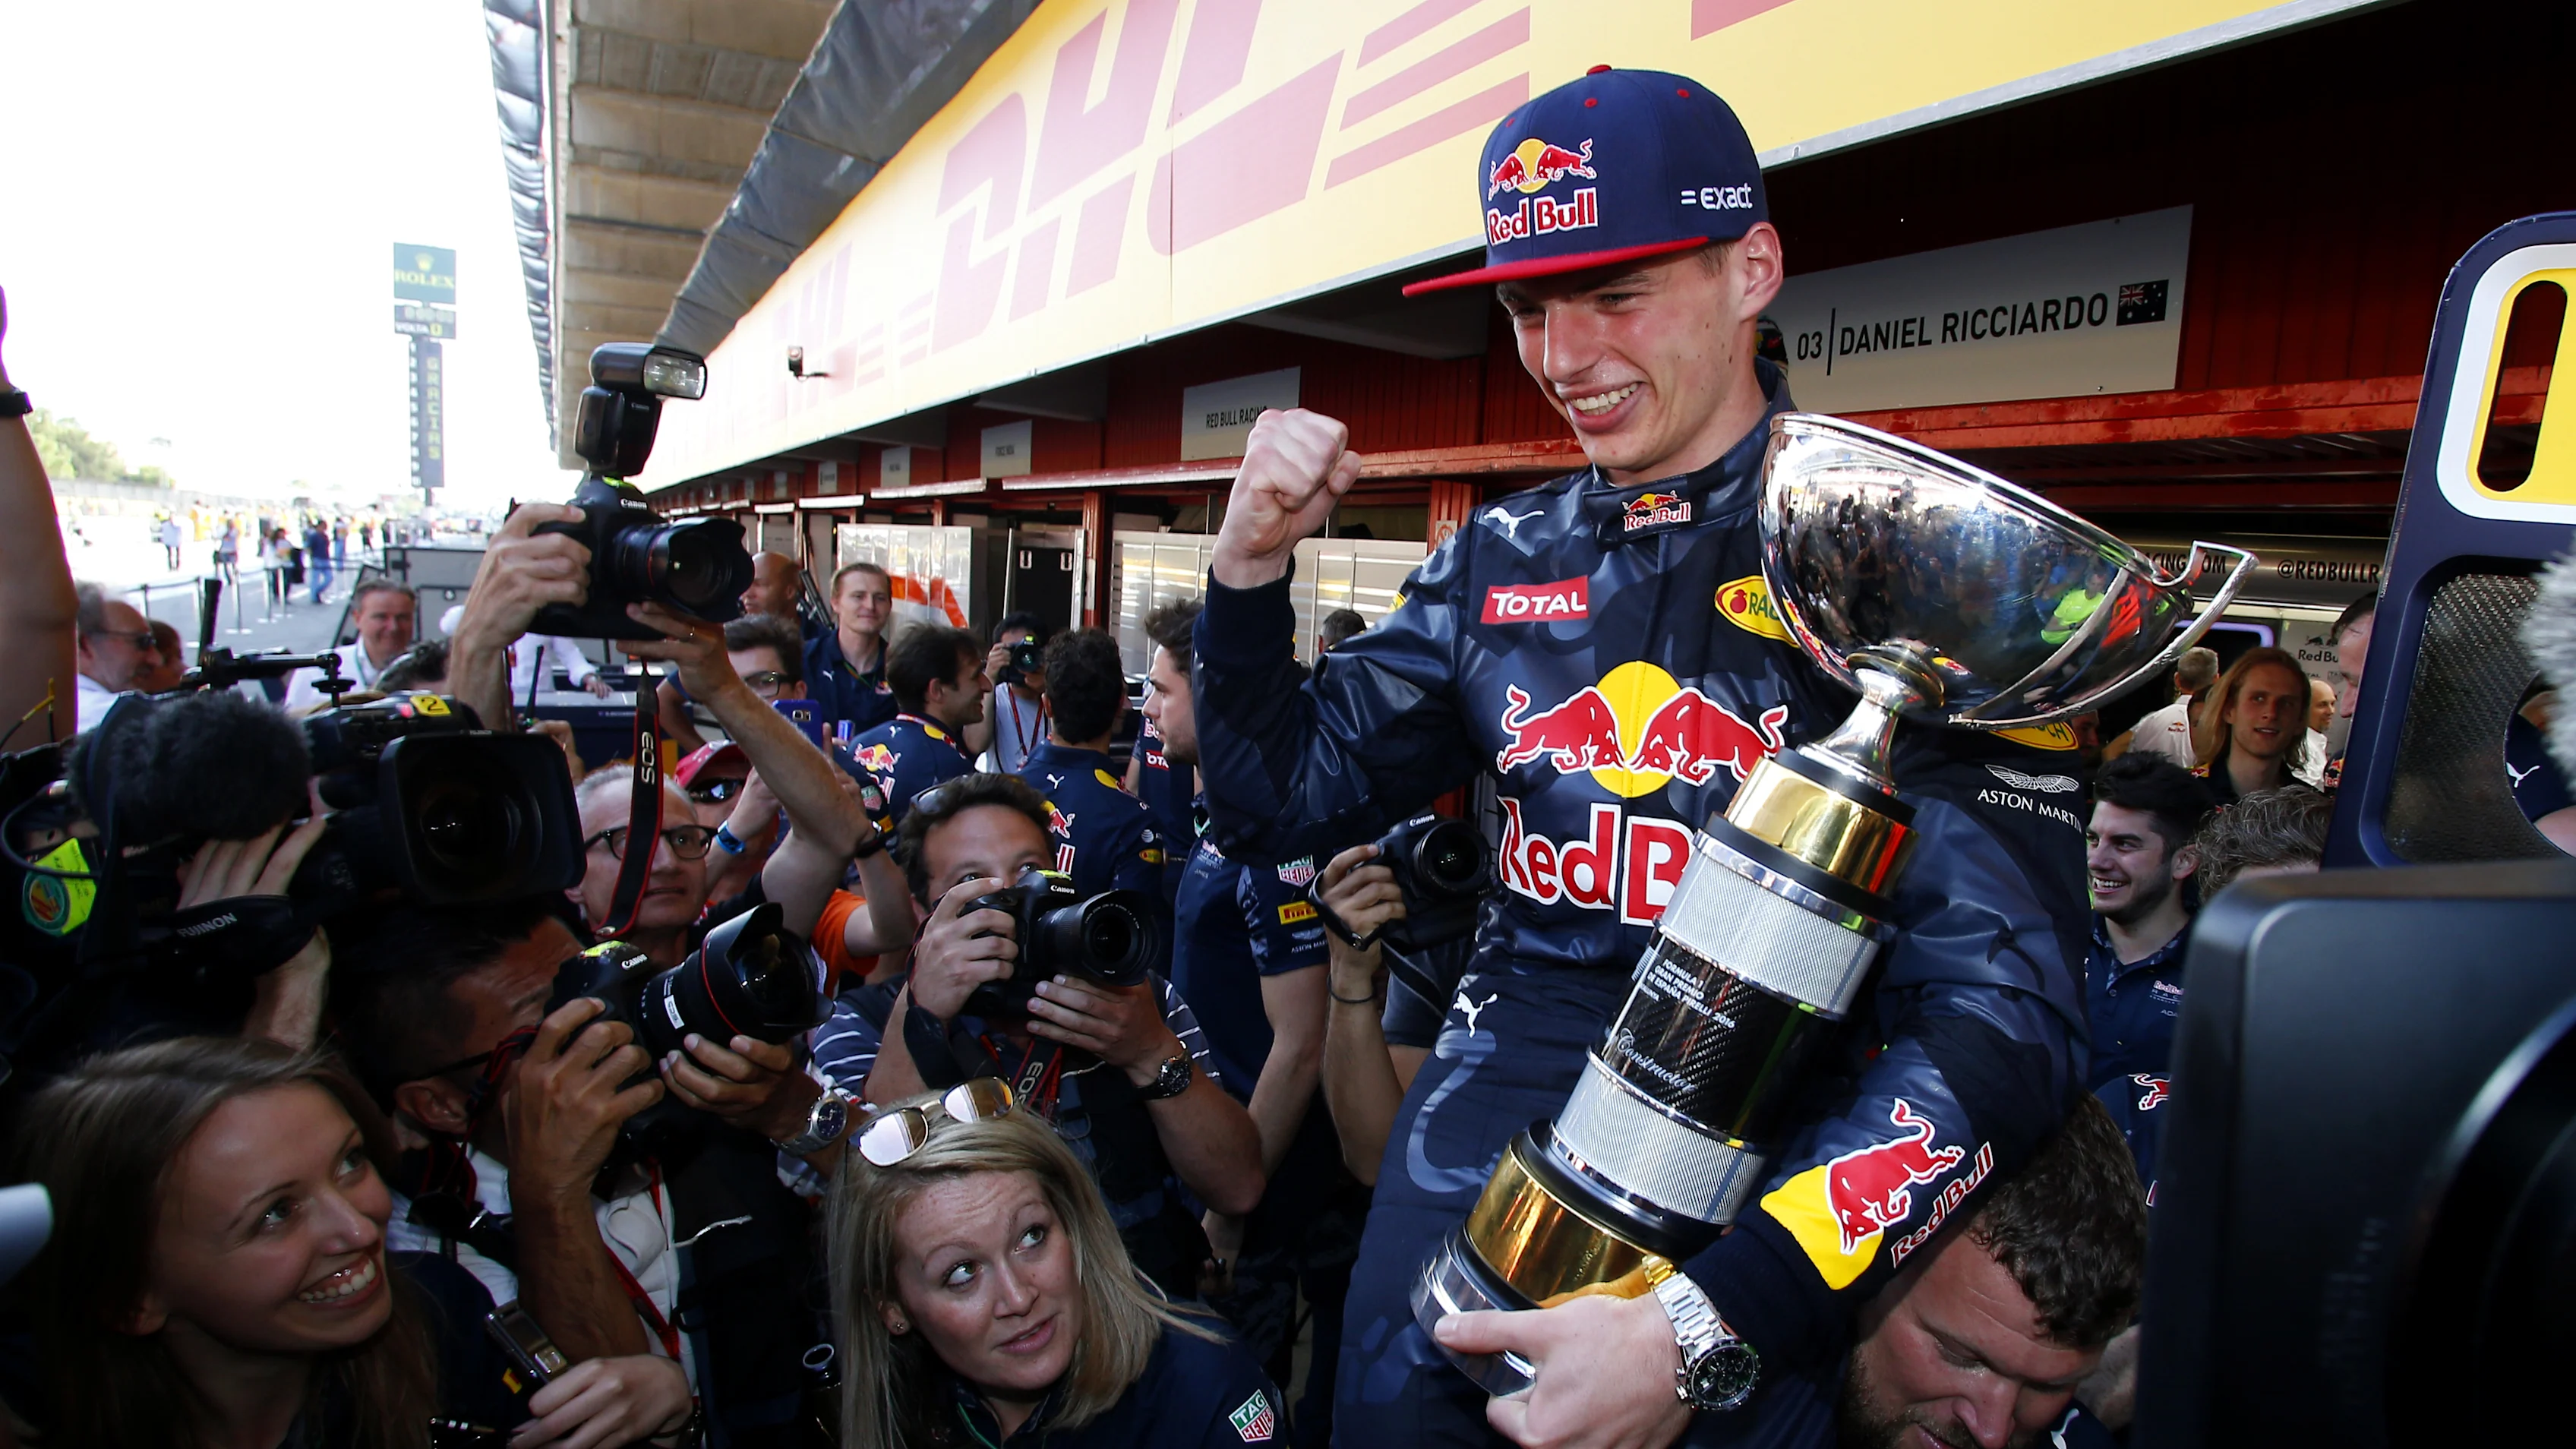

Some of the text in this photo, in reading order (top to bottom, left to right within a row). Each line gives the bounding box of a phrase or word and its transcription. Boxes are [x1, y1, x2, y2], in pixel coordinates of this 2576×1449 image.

[930, 0, 1345, 355] DHL
[1700, 182, 1754, 210] exact
[1487, 187, 1599, 247] Red Bull
[394, 268, 455, 289] ROLEX
[1839, 292, 2108, 355] DANIEL RICCIARDO
[1797, 330, 1823, 361] 03
[1206, 406, 1267, 428] RED BULL RACIN
[620, 497, 647, 510] Canon
[1624, 501, 1692, 532] Red Bull
[1491, 590, 1587, 618] TOTAL
[1748, 593, 1779, 620] RAU
[2298, 649, 2338, 663] Red Bu
[421, 697, 444, 711] 2
[641, 731, 655, 785] EOS
[1977, 788, 2033, 812] ASTON
[1409, 813, 1435, 827] Canon
[1495, 795, 1621, 911] Red
[1050, 885, 1075, 895] Canon
[177, 913, 238, 937] FUJINON
[621, 954, 648, 970] Canon
[1291, 942, 1312, 953] ASTON
[1654, 964, 1705, 1000] GRAN PREMIO
[1662, 958, 1704, 988] FORMULA 1
[1647, 972, 1735, 1029] DE ESPAÑA PIRELLI 2016
[1617, 1027, 1697, 1094] Constructor
[1891, 1141, 1994, 1269] Red Bull
[1234, 1394, 1265, 1424] TAG
[1243, 1407, 1272, 1438] HEUER
